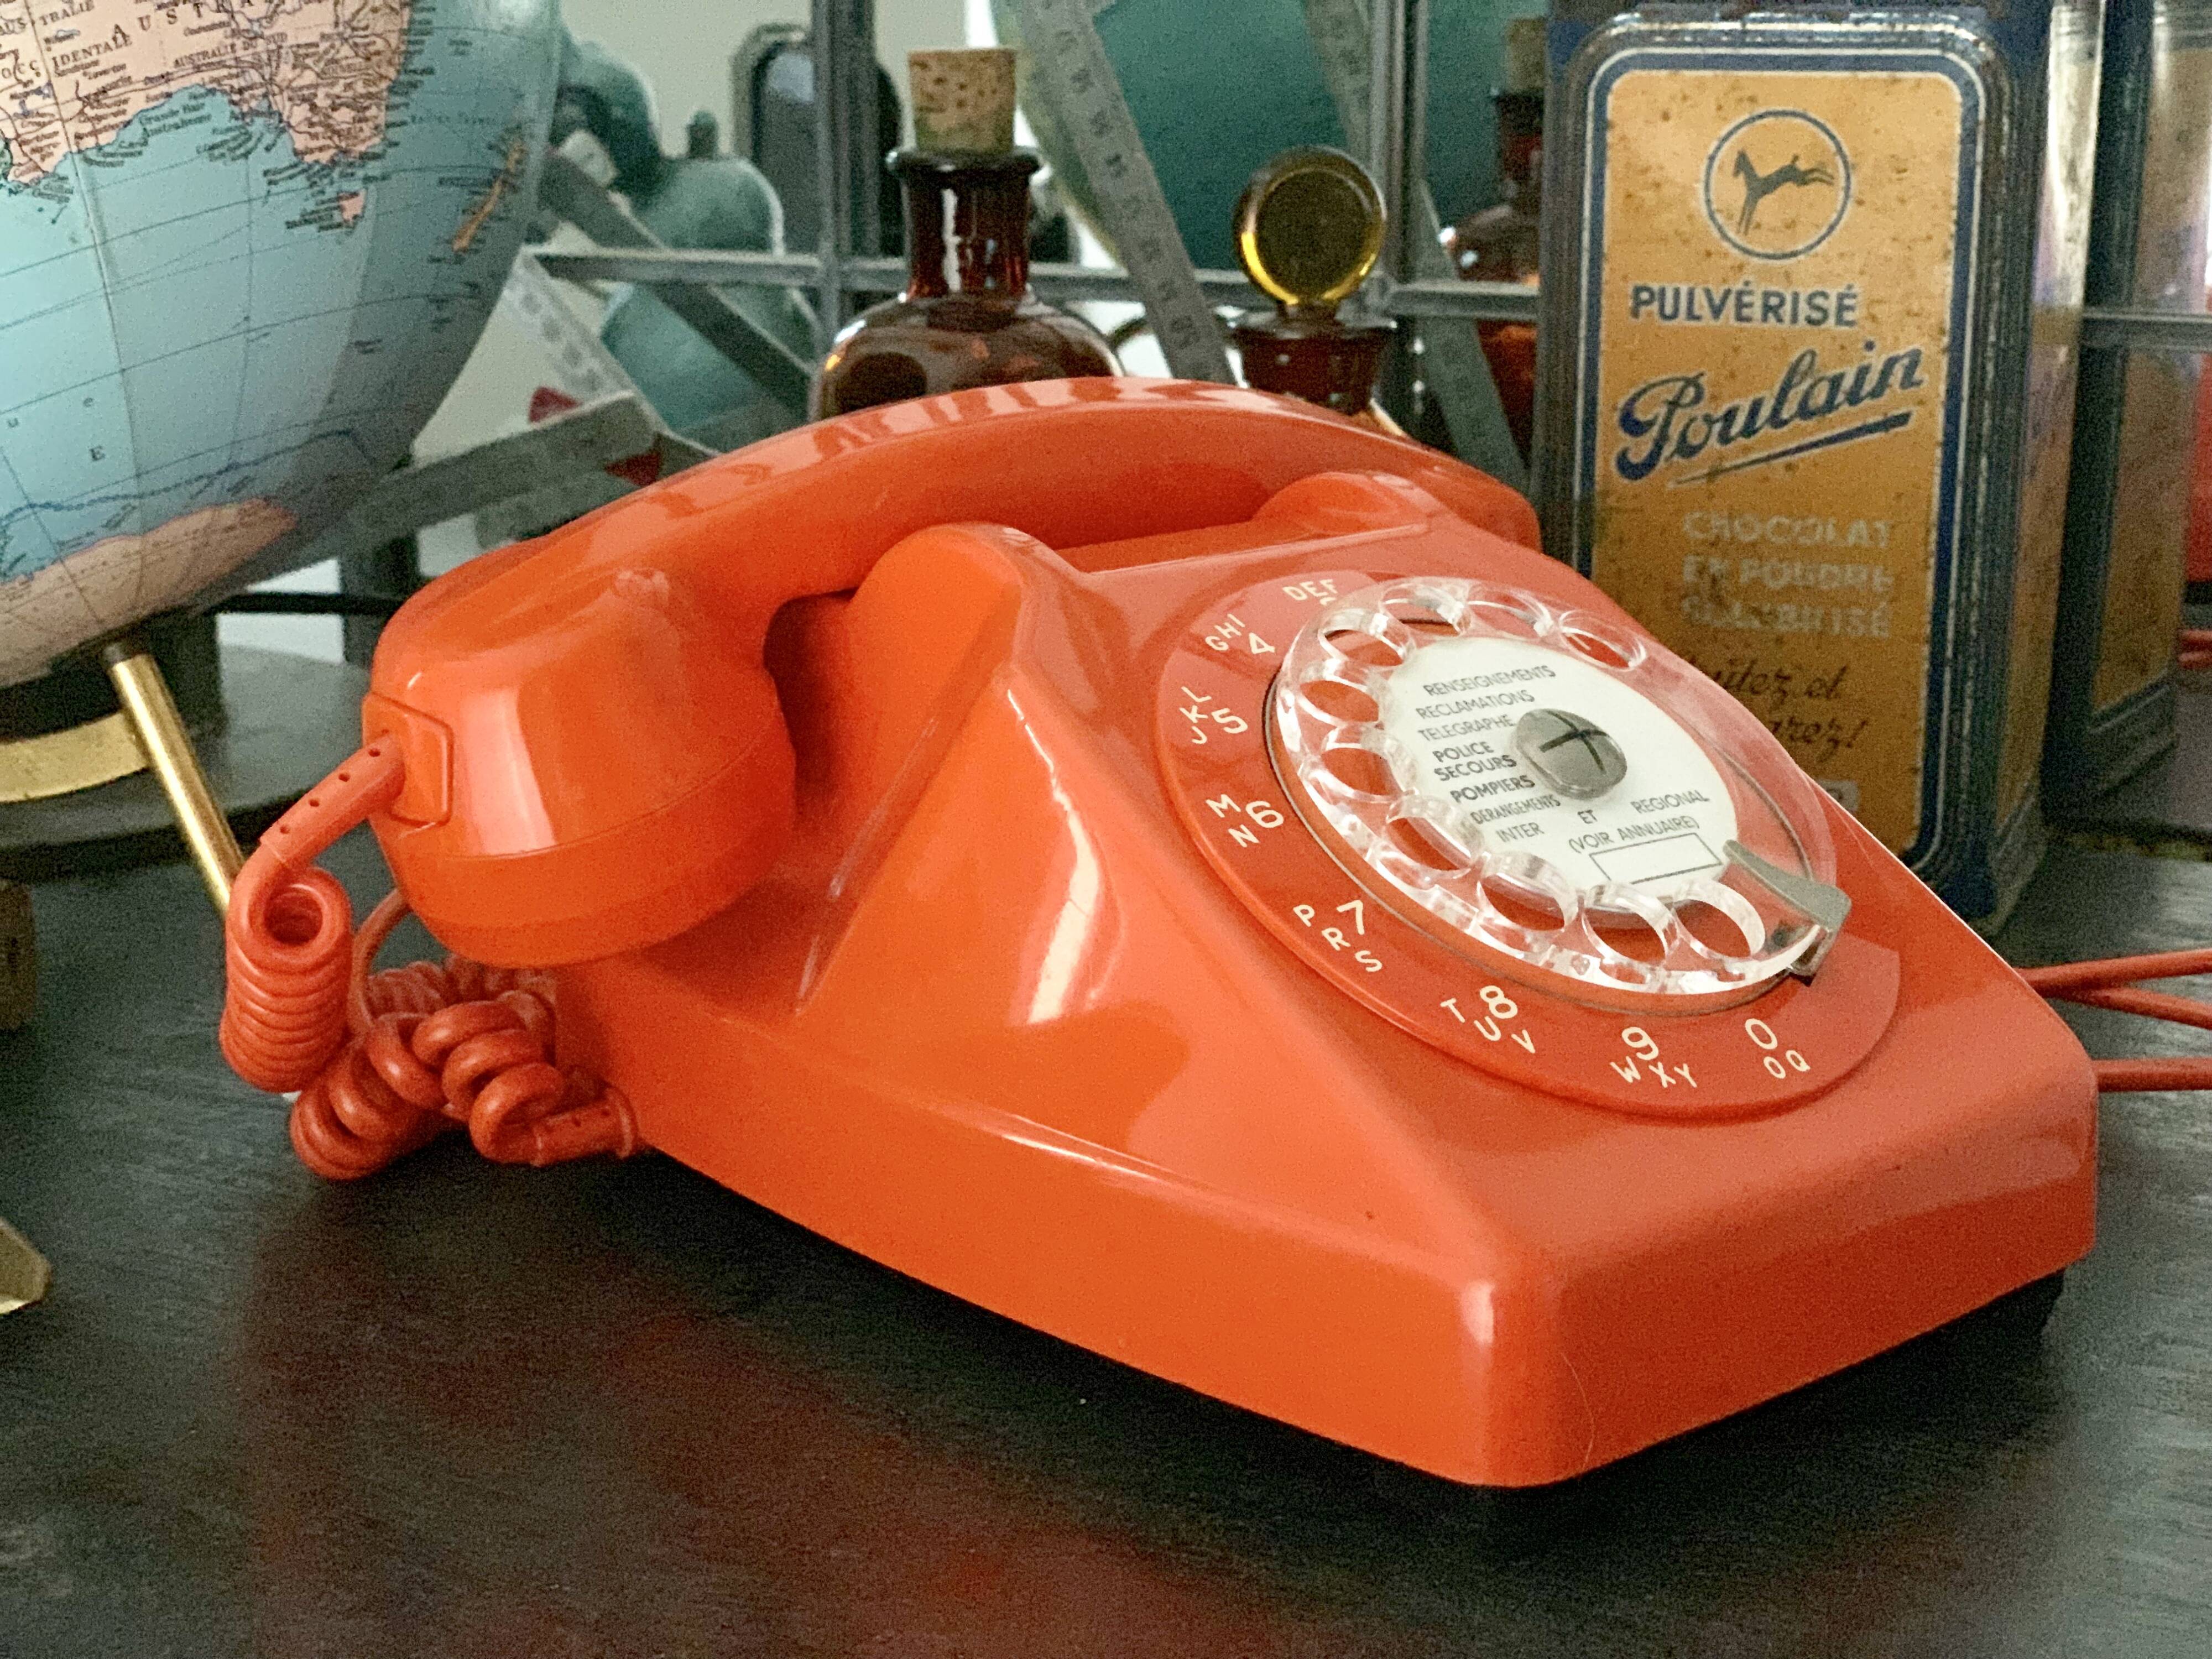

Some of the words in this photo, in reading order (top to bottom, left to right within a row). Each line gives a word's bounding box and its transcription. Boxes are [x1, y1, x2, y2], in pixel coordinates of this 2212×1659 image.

[1630, 280, 1858, 327] PULVÉRISÉ
[1615, 339, 1923, 480] Poulain
[1683, 511, 1891, 549] CHOCOLAT
[1282, 579, 1337, 601] DEF
[1205, 614, 1245, 651] GHI
[1249, 632, 1275, 655] 4
[1422, 665, 1556, 696] RENSEIGNEMENTS
[1415, 690, 1535, 719] RECLAMATIONS
[1211, 708, 1248, 734] 5
[1418, 714, 1516, 742] TELEGRAPHE
[1432, 741, 1494, 763] POLICE
[1434, 754, 1517, 781] SECOURS
[1450, 775, 1535, 804] POMPIERS
[1245, 800, 1284, 828] 6
[1470, 794, 1561, 825] DERANGEMENTS
[1496, 822, 1545, 843] INTER
[1577, 808, 1598, 825] ET
[1630, 789, 1710, 815] REGIONAL
[1568, 831, 1614, 854] (VOIR
[1619, 815, 1700, 842] ANNUAIRE)
[1337, 899, 1365, 936] 7
[1479, 985, 1519, 1020] 8
[1621, 1026, 1660, 1061] 9
[1745, 1018, 1777, 1051] 0
